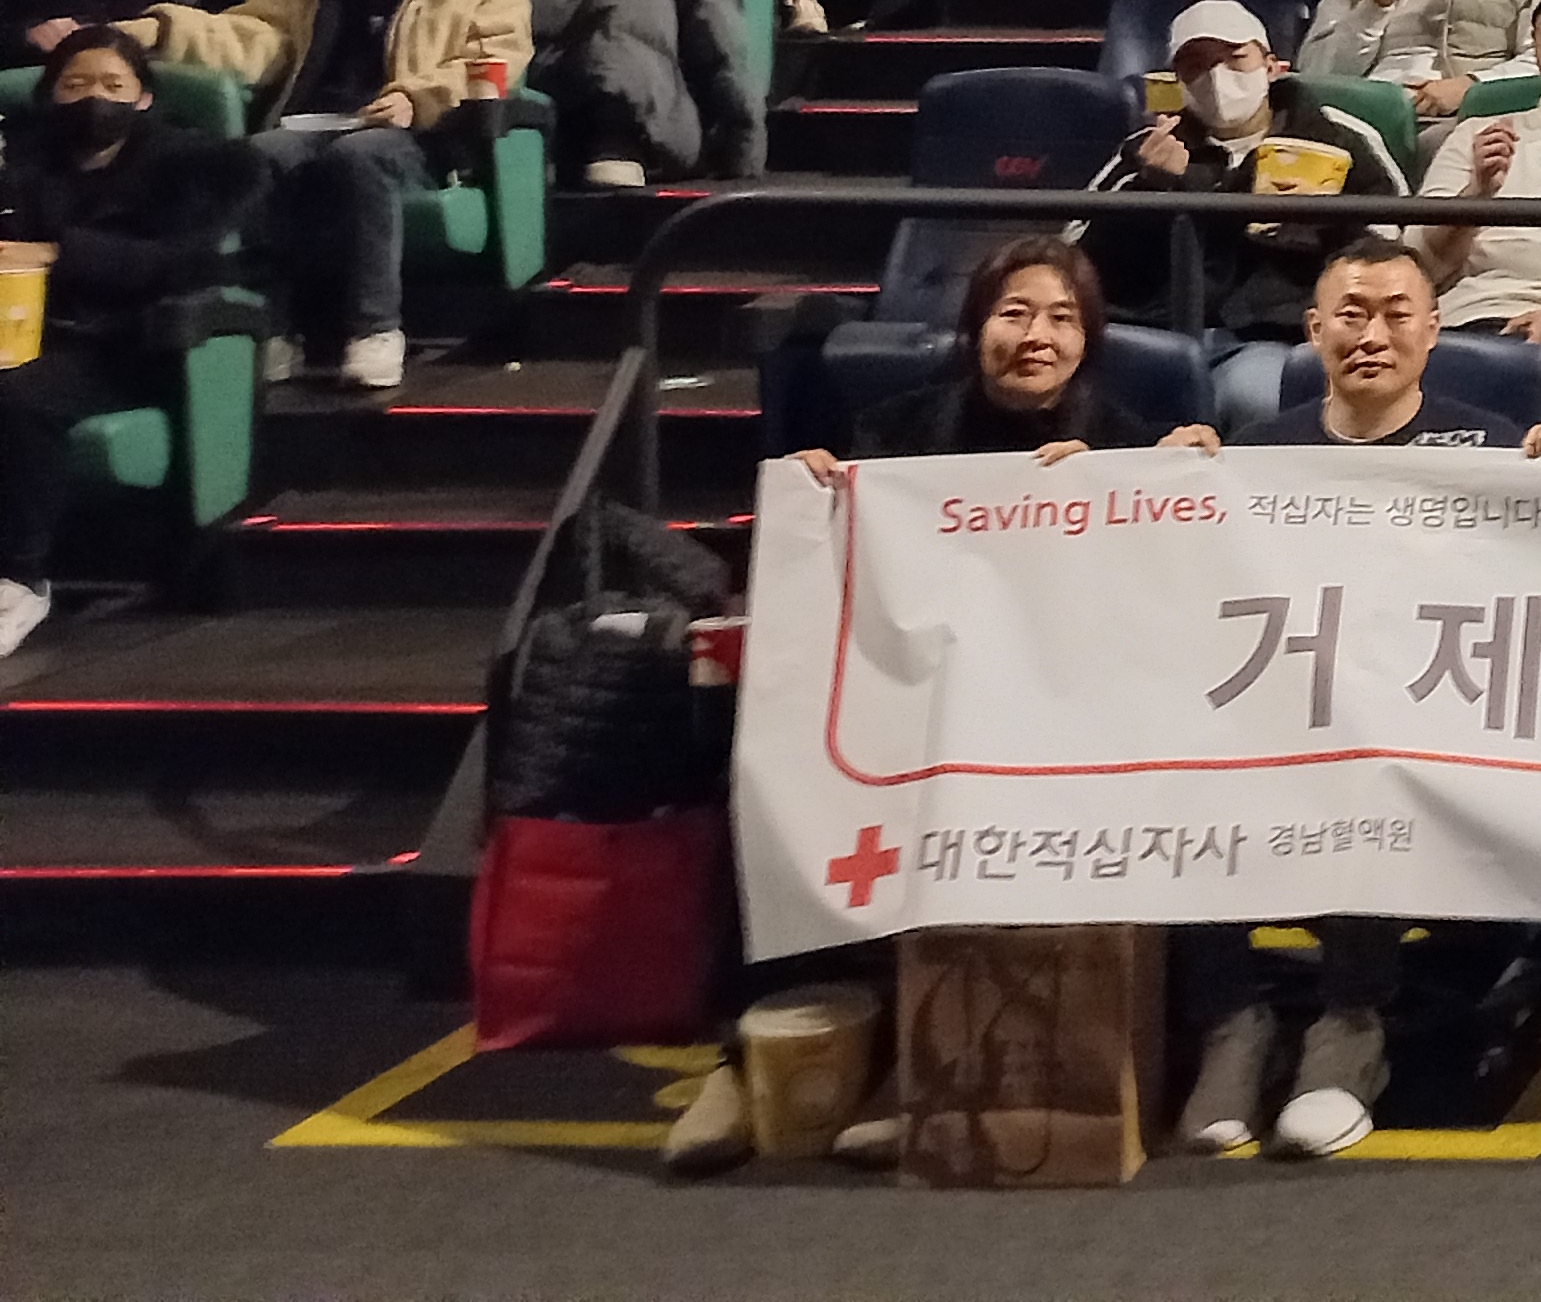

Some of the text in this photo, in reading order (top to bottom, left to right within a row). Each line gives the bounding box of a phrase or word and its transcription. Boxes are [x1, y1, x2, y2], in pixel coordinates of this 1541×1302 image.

[937, 489, 1229, 536] Saving Lives,
[1248, 494, 1375, 526] 적십자는
[917, 817, 1414, 881] 대한적십자사 경남혈액원
